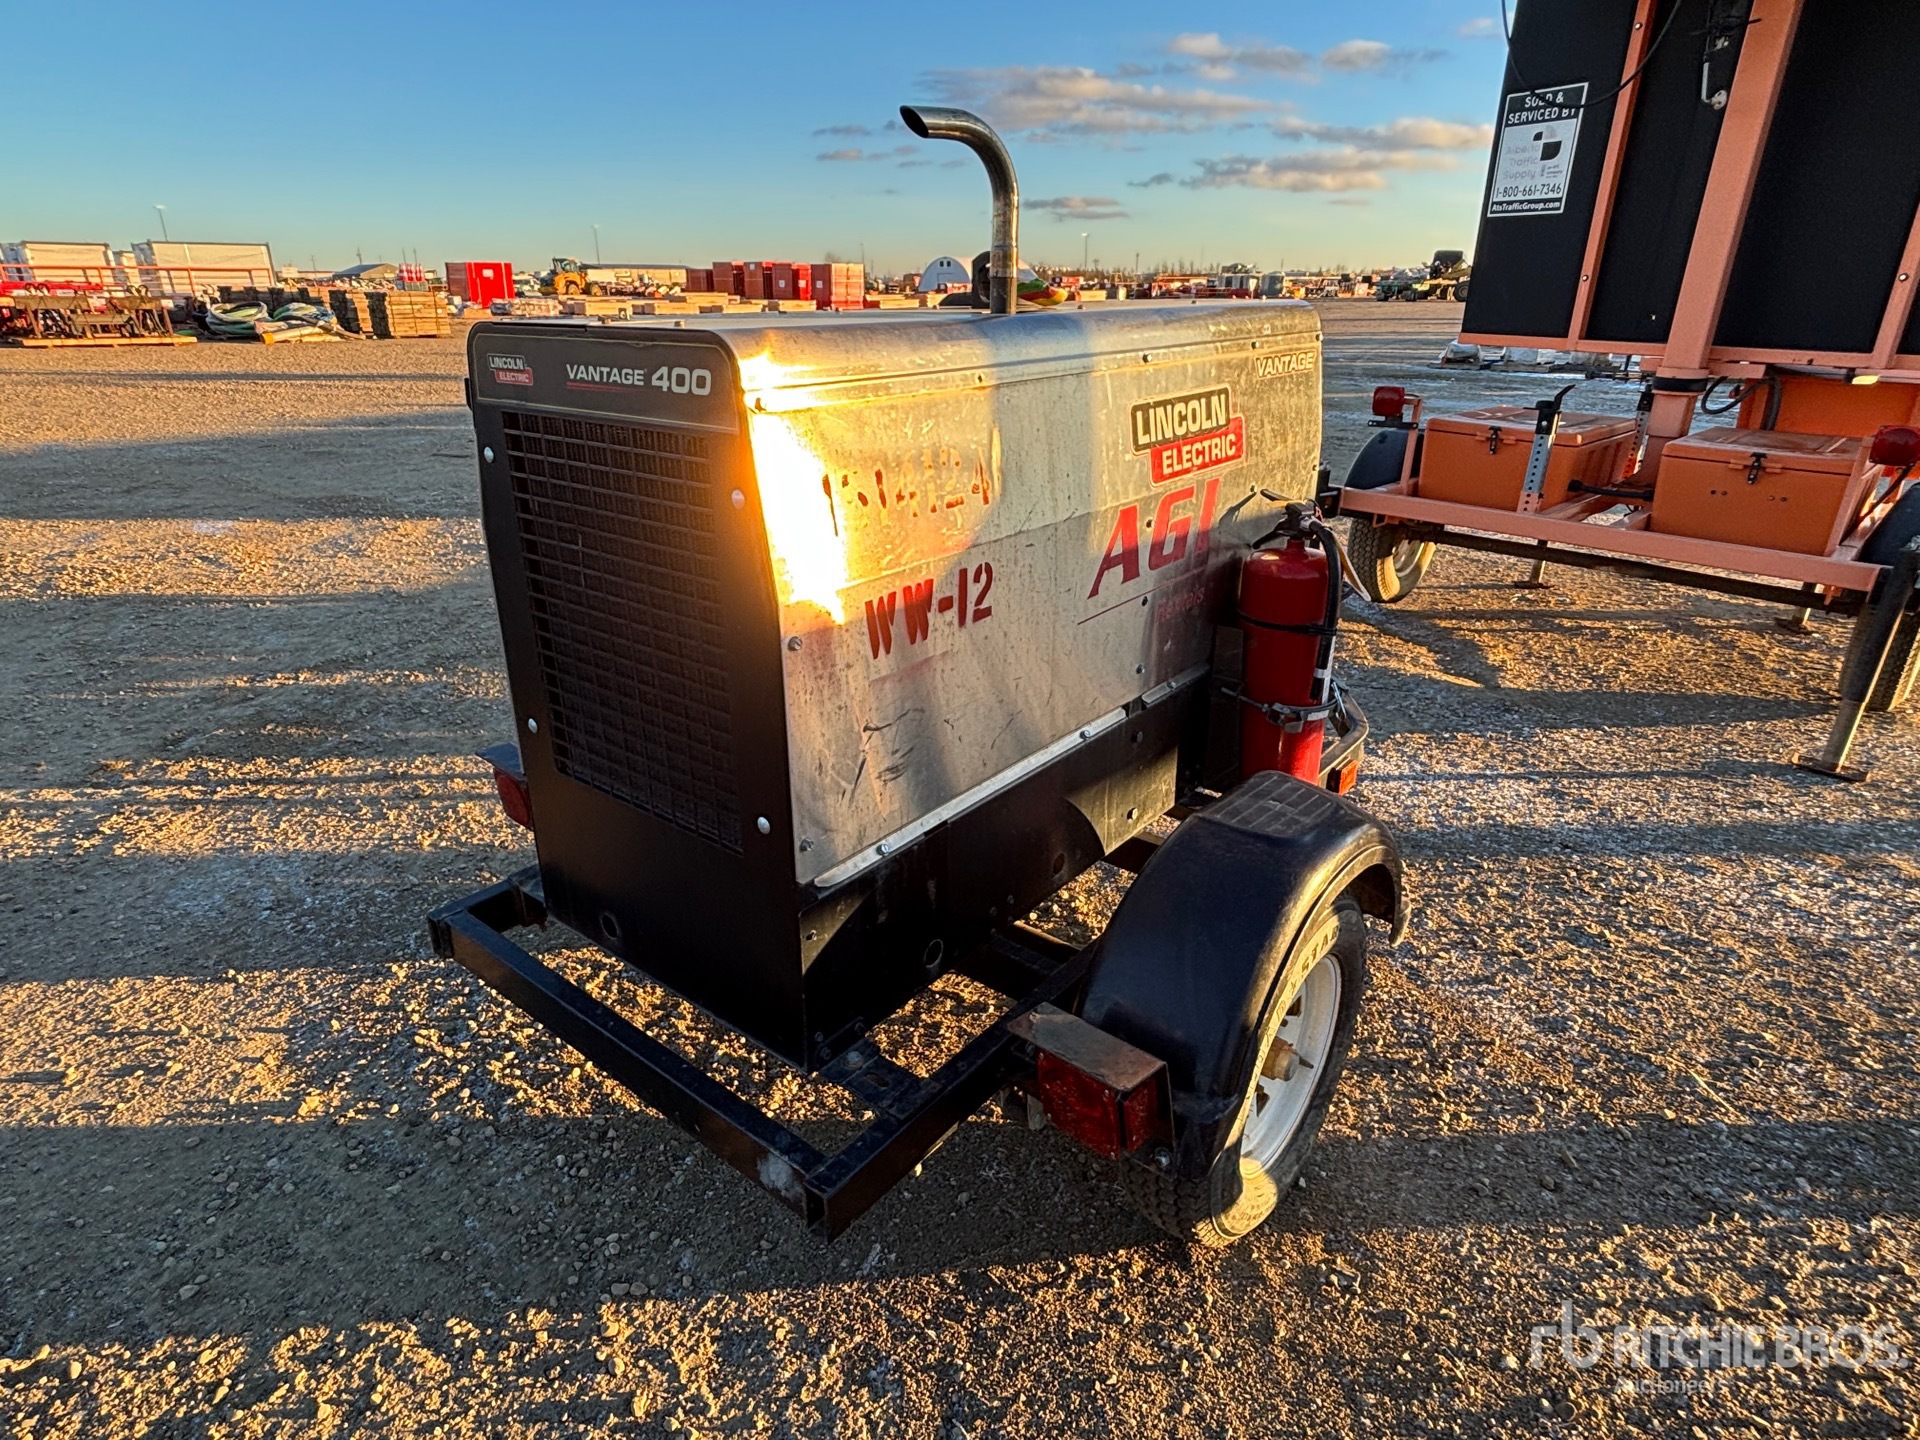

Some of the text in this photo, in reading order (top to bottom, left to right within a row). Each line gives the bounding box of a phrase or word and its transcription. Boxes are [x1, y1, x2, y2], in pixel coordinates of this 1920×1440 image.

[1556, 91, 1564, 103] &
[1508, 107, 1559, 124] SERVICED
[1503, 169, 1536, 181] Supply
[1496, 183, 1562, 199] 1-800-661-7346
[1492, 201, 1560, 212] AtsTrafficGroup.com
[489, 356, 524, 370] LINCOLN
[1256, 352, 1314, 377] VANTAGE
[498, 371, 529, 383] ELECTRIC
[566, 364, 712, 396] VANTAGE 400
[1136, 394, 1227, 446] LINCOLN
[1162, 434, 1236, 476] ELECTRIC
[1087, 476, 1222, 600] AGI
[865, 562, 993, 660] WW-12
